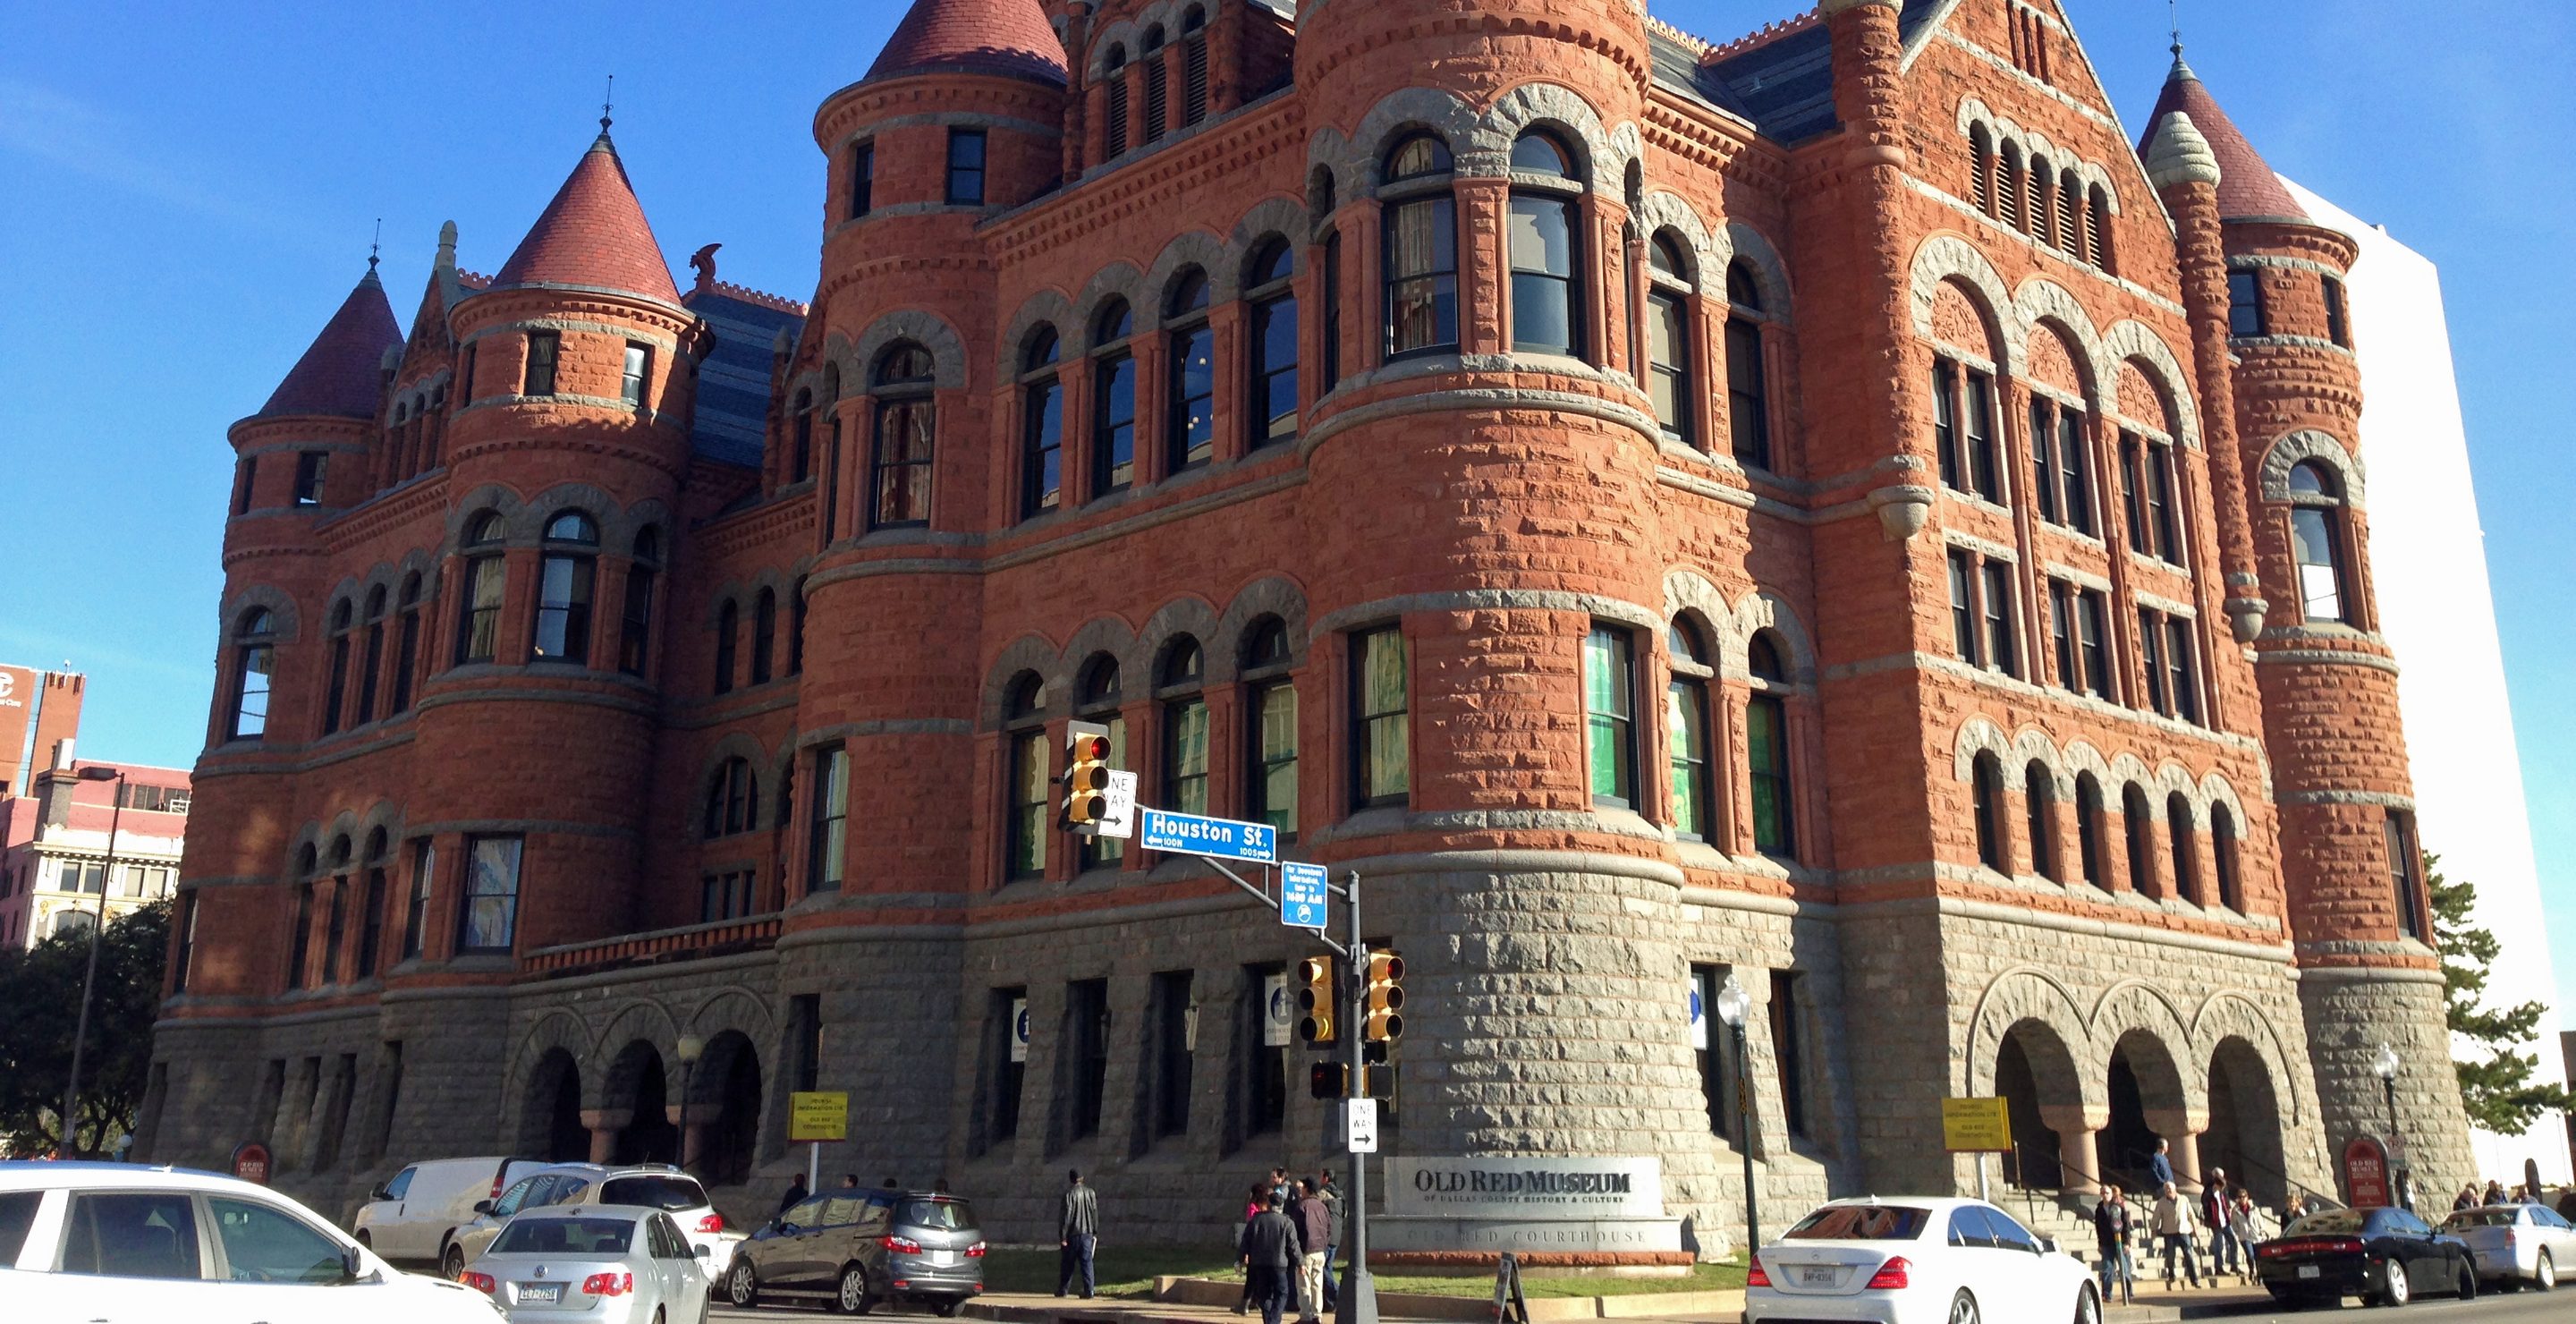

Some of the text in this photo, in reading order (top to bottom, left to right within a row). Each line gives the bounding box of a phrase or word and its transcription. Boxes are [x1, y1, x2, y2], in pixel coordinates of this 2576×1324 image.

[1152, 814, 1267, 848] Houston St.
[1353, 1104, 1372, 1116] ONE
[1353, 1120, 1372, 1129] WAY
[1415, 1169, 1631, 1194] OLD RED MUSEUM
[1440, 1195, 1477, 1203] DALLAS
[1408, 1231, 1646, 1243] OLD RED COURTHOUSE
